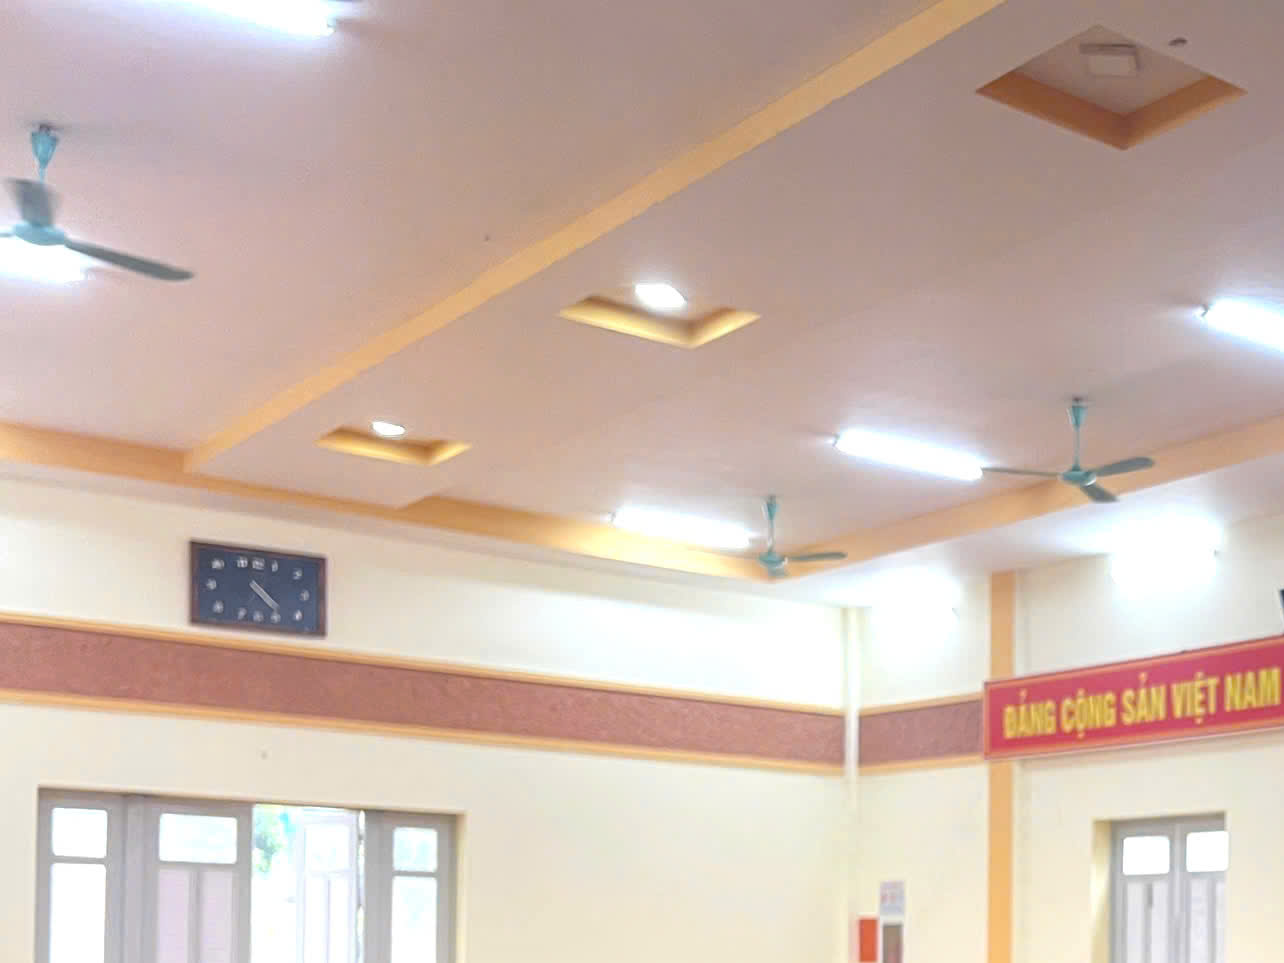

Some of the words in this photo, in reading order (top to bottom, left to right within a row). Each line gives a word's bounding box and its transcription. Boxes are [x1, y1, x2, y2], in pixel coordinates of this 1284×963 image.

[1004, 689, 1056, 740] ĐẢNG
[1060, 688, 1116, 739] CỘNG
[1121, 672, 1167, 726] SẢN
[1171, 672, 1220, 724] VIỆT
[1224, 667, 1281, 712] NAM
